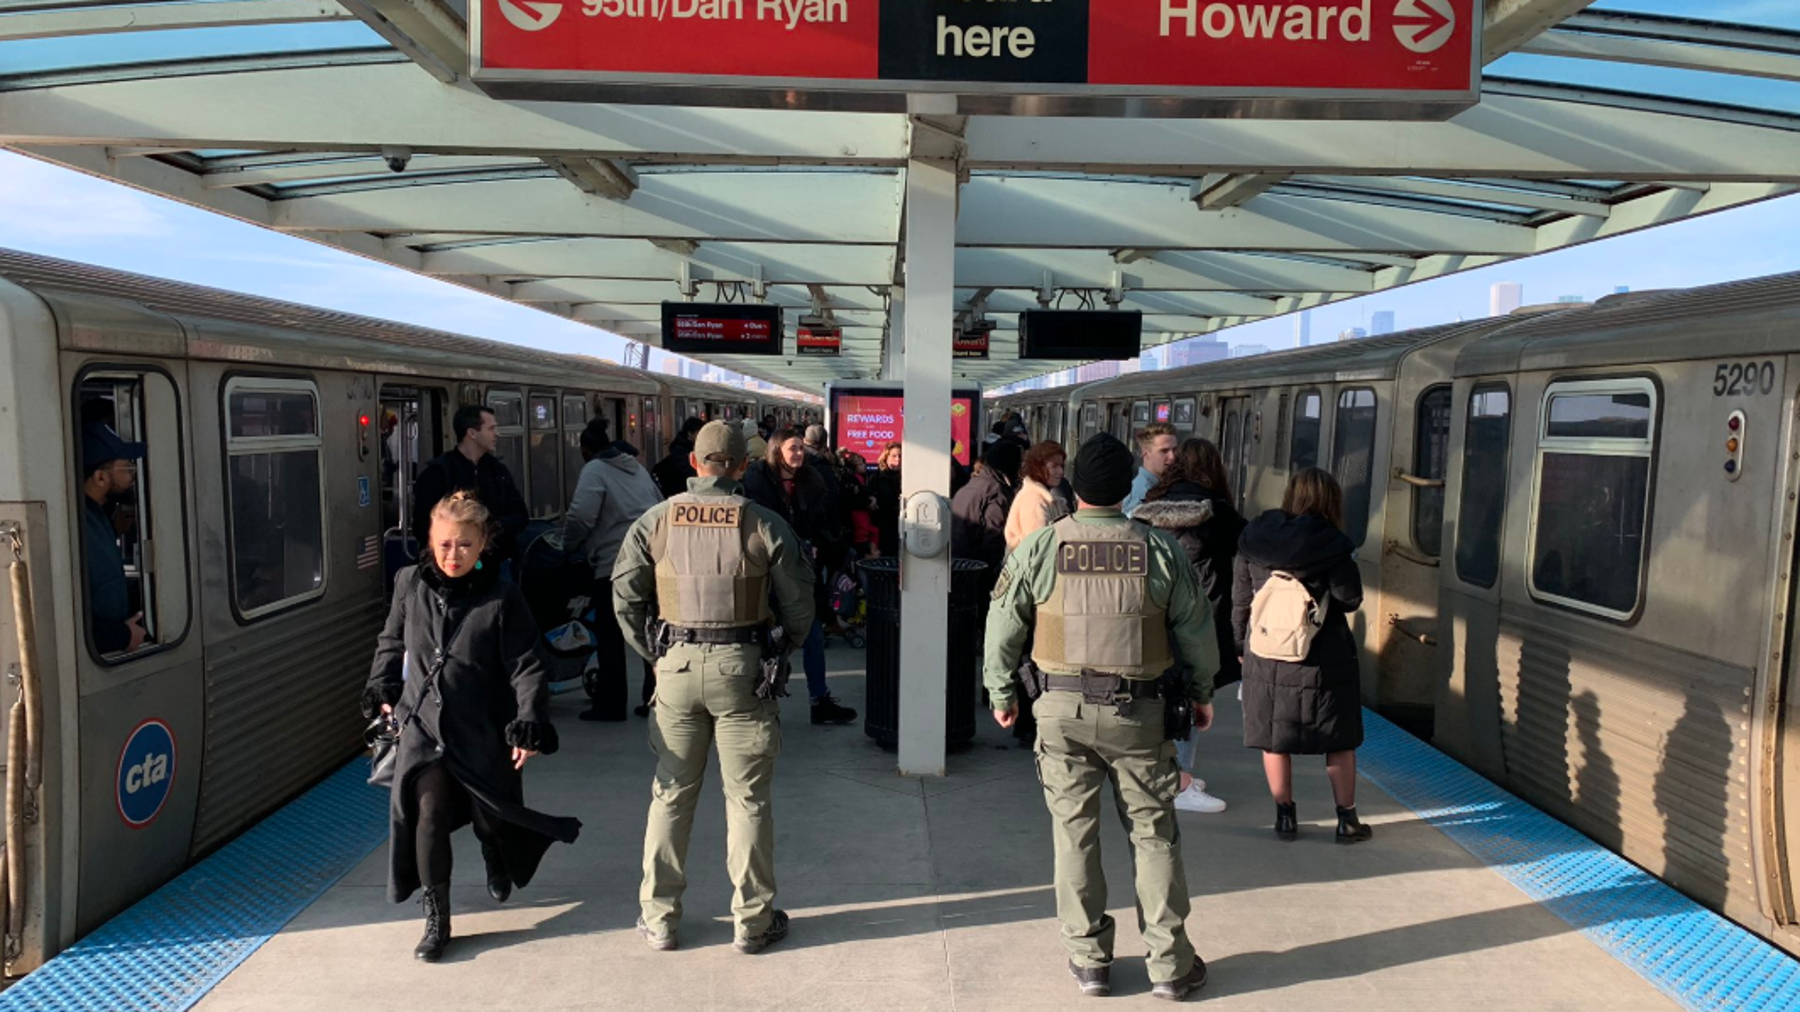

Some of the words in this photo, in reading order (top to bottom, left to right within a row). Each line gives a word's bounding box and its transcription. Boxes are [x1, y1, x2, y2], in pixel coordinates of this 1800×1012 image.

[936, 15, 1035, 58] here
[1159, 0, 1371, 41] Howard
[1713, 360, 1775, 396] 5290
[847, 414, 894, 424] REWARDS
[847, 430, 867, 439] FREE
[869, 430, 894, 439] FOOD
[674, 505, 736, 524] POLICE
[1063, 544, 1140, 572] POLICE
[126, 752, 168, 794] cta
